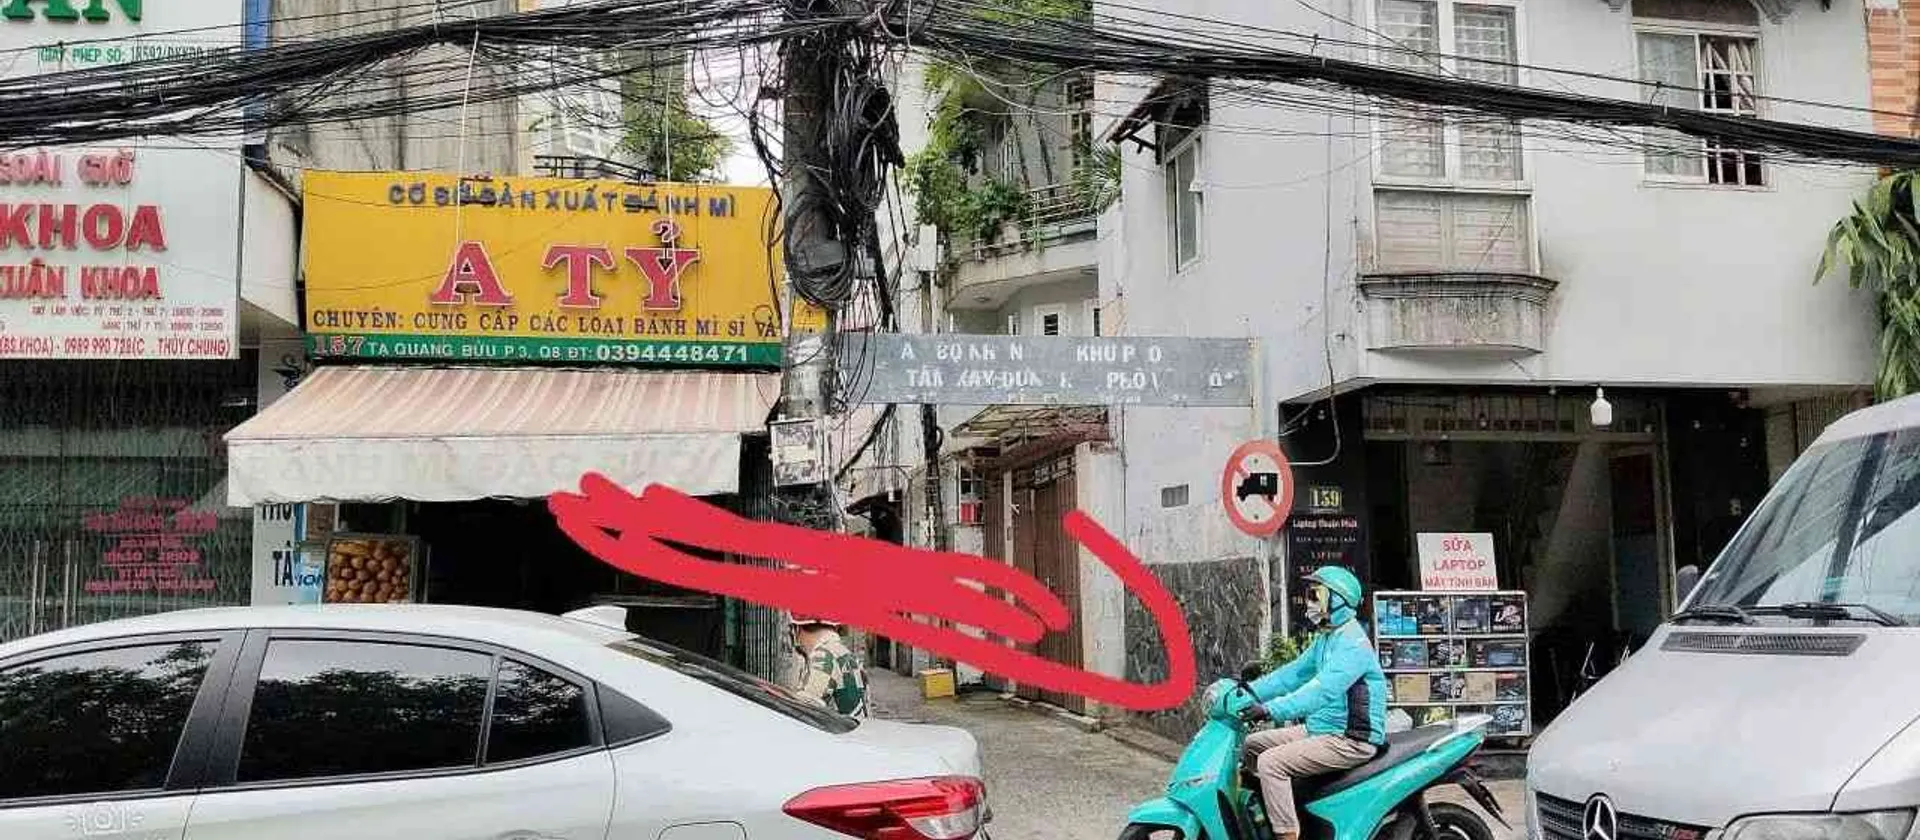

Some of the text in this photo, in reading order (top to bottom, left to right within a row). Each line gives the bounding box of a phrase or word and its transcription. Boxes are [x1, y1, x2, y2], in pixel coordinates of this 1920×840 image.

[77, 149, 134, 187] GIỜ
[388, 182, 427, 205] CƠ
[545, 184, 617, 214] XUẤT
[624, 188, 700, 217] BÁNH
[709, 192, 736, 218] MÌ
[0, 203, 167, 251] KHOA
[431, 217, 702, 312] A TỶ
[81, 265, 163, 300] KHOA
[312, 305, 404, 328] CHUYÊN:
[413, 312, 468, 331] CUNG
[478, 306, 519, 332] CẤP
[529, 308, 568, 333] CÁC
[578, 316, 625, 337] LOẠI
[634, 311, 687, 336] BÁNH
[696, 315, 721, 337] MÌ
[312, 334, 364, 357] 157
[394, 341, 446, 358] QUANG
[596, 344, 748, 362] 0394448471
[1443, 536, 1473, 552] SỬA
[1433, 559, 1486, 571] LAPTOP
